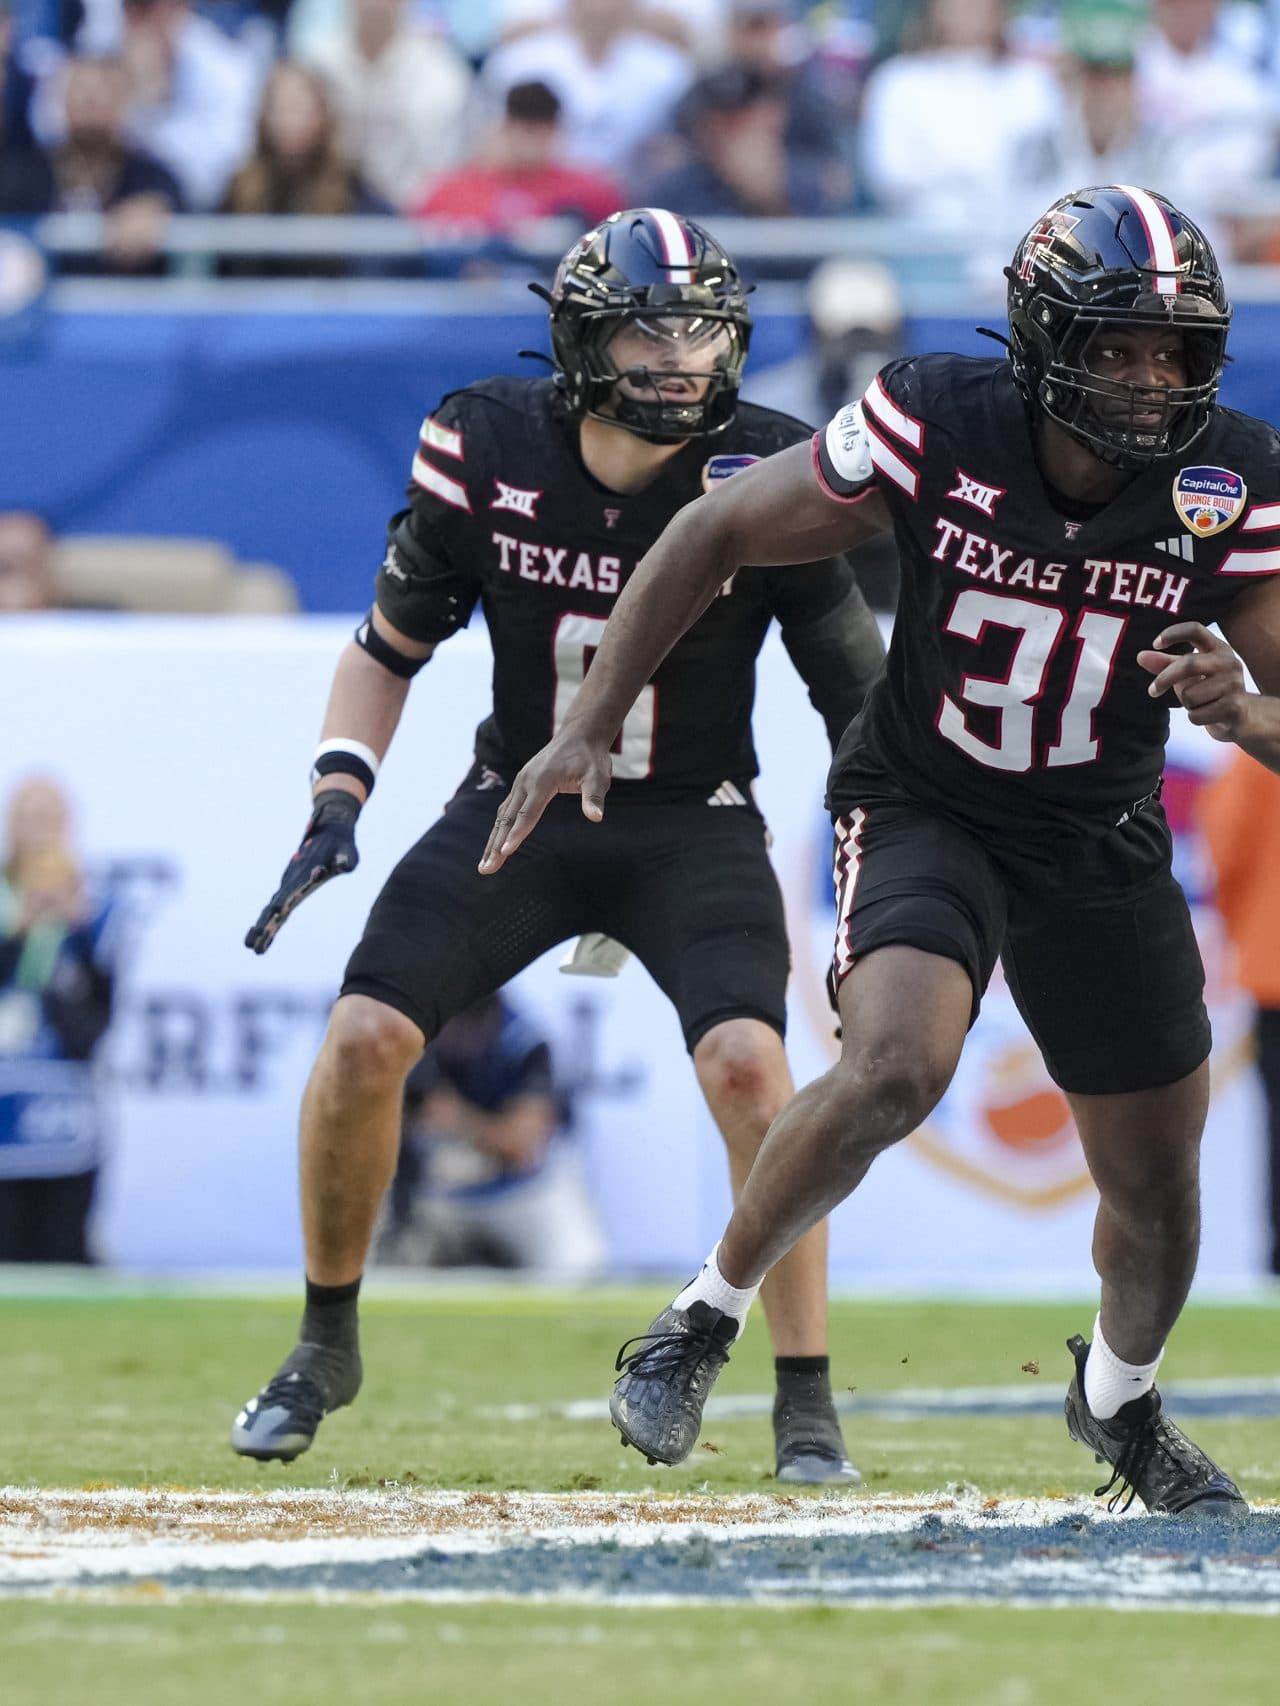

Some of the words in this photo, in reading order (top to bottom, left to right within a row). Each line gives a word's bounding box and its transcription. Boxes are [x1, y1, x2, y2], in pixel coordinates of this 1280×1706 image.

[1180, 493, 1211, 506] ORANGE
[1213, 497, 1235, 513] BOWL
[491, 531, 621, 594] TEXAS
[931, 517, 1068, 592] TEXAS
[1082, 556, 1191, 615] TECH
[935, 587, 1130, 774] 31
